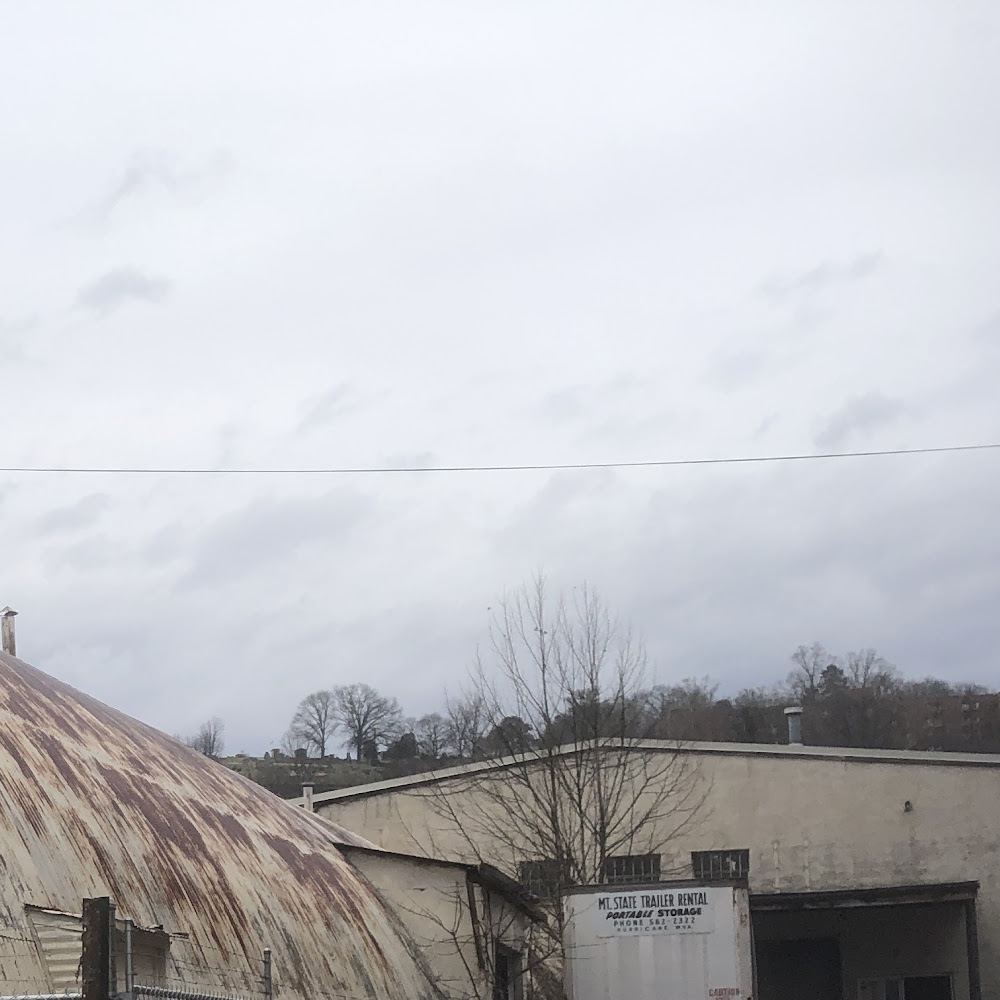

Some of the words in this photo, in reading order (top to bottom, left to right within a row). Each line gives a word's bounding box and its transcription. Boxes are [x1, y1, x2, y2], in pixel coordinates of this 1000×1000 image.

[641, 893, 674, 908] TRAILER
[678, 892, 708, 906] RENTAL
[606, 910, 654, 920] PORTABLE
[657, 907, 702, 917] STORAGE
[613, 919, 644, 927] PHONE
[708, 988, 740, 997] CAUTION
